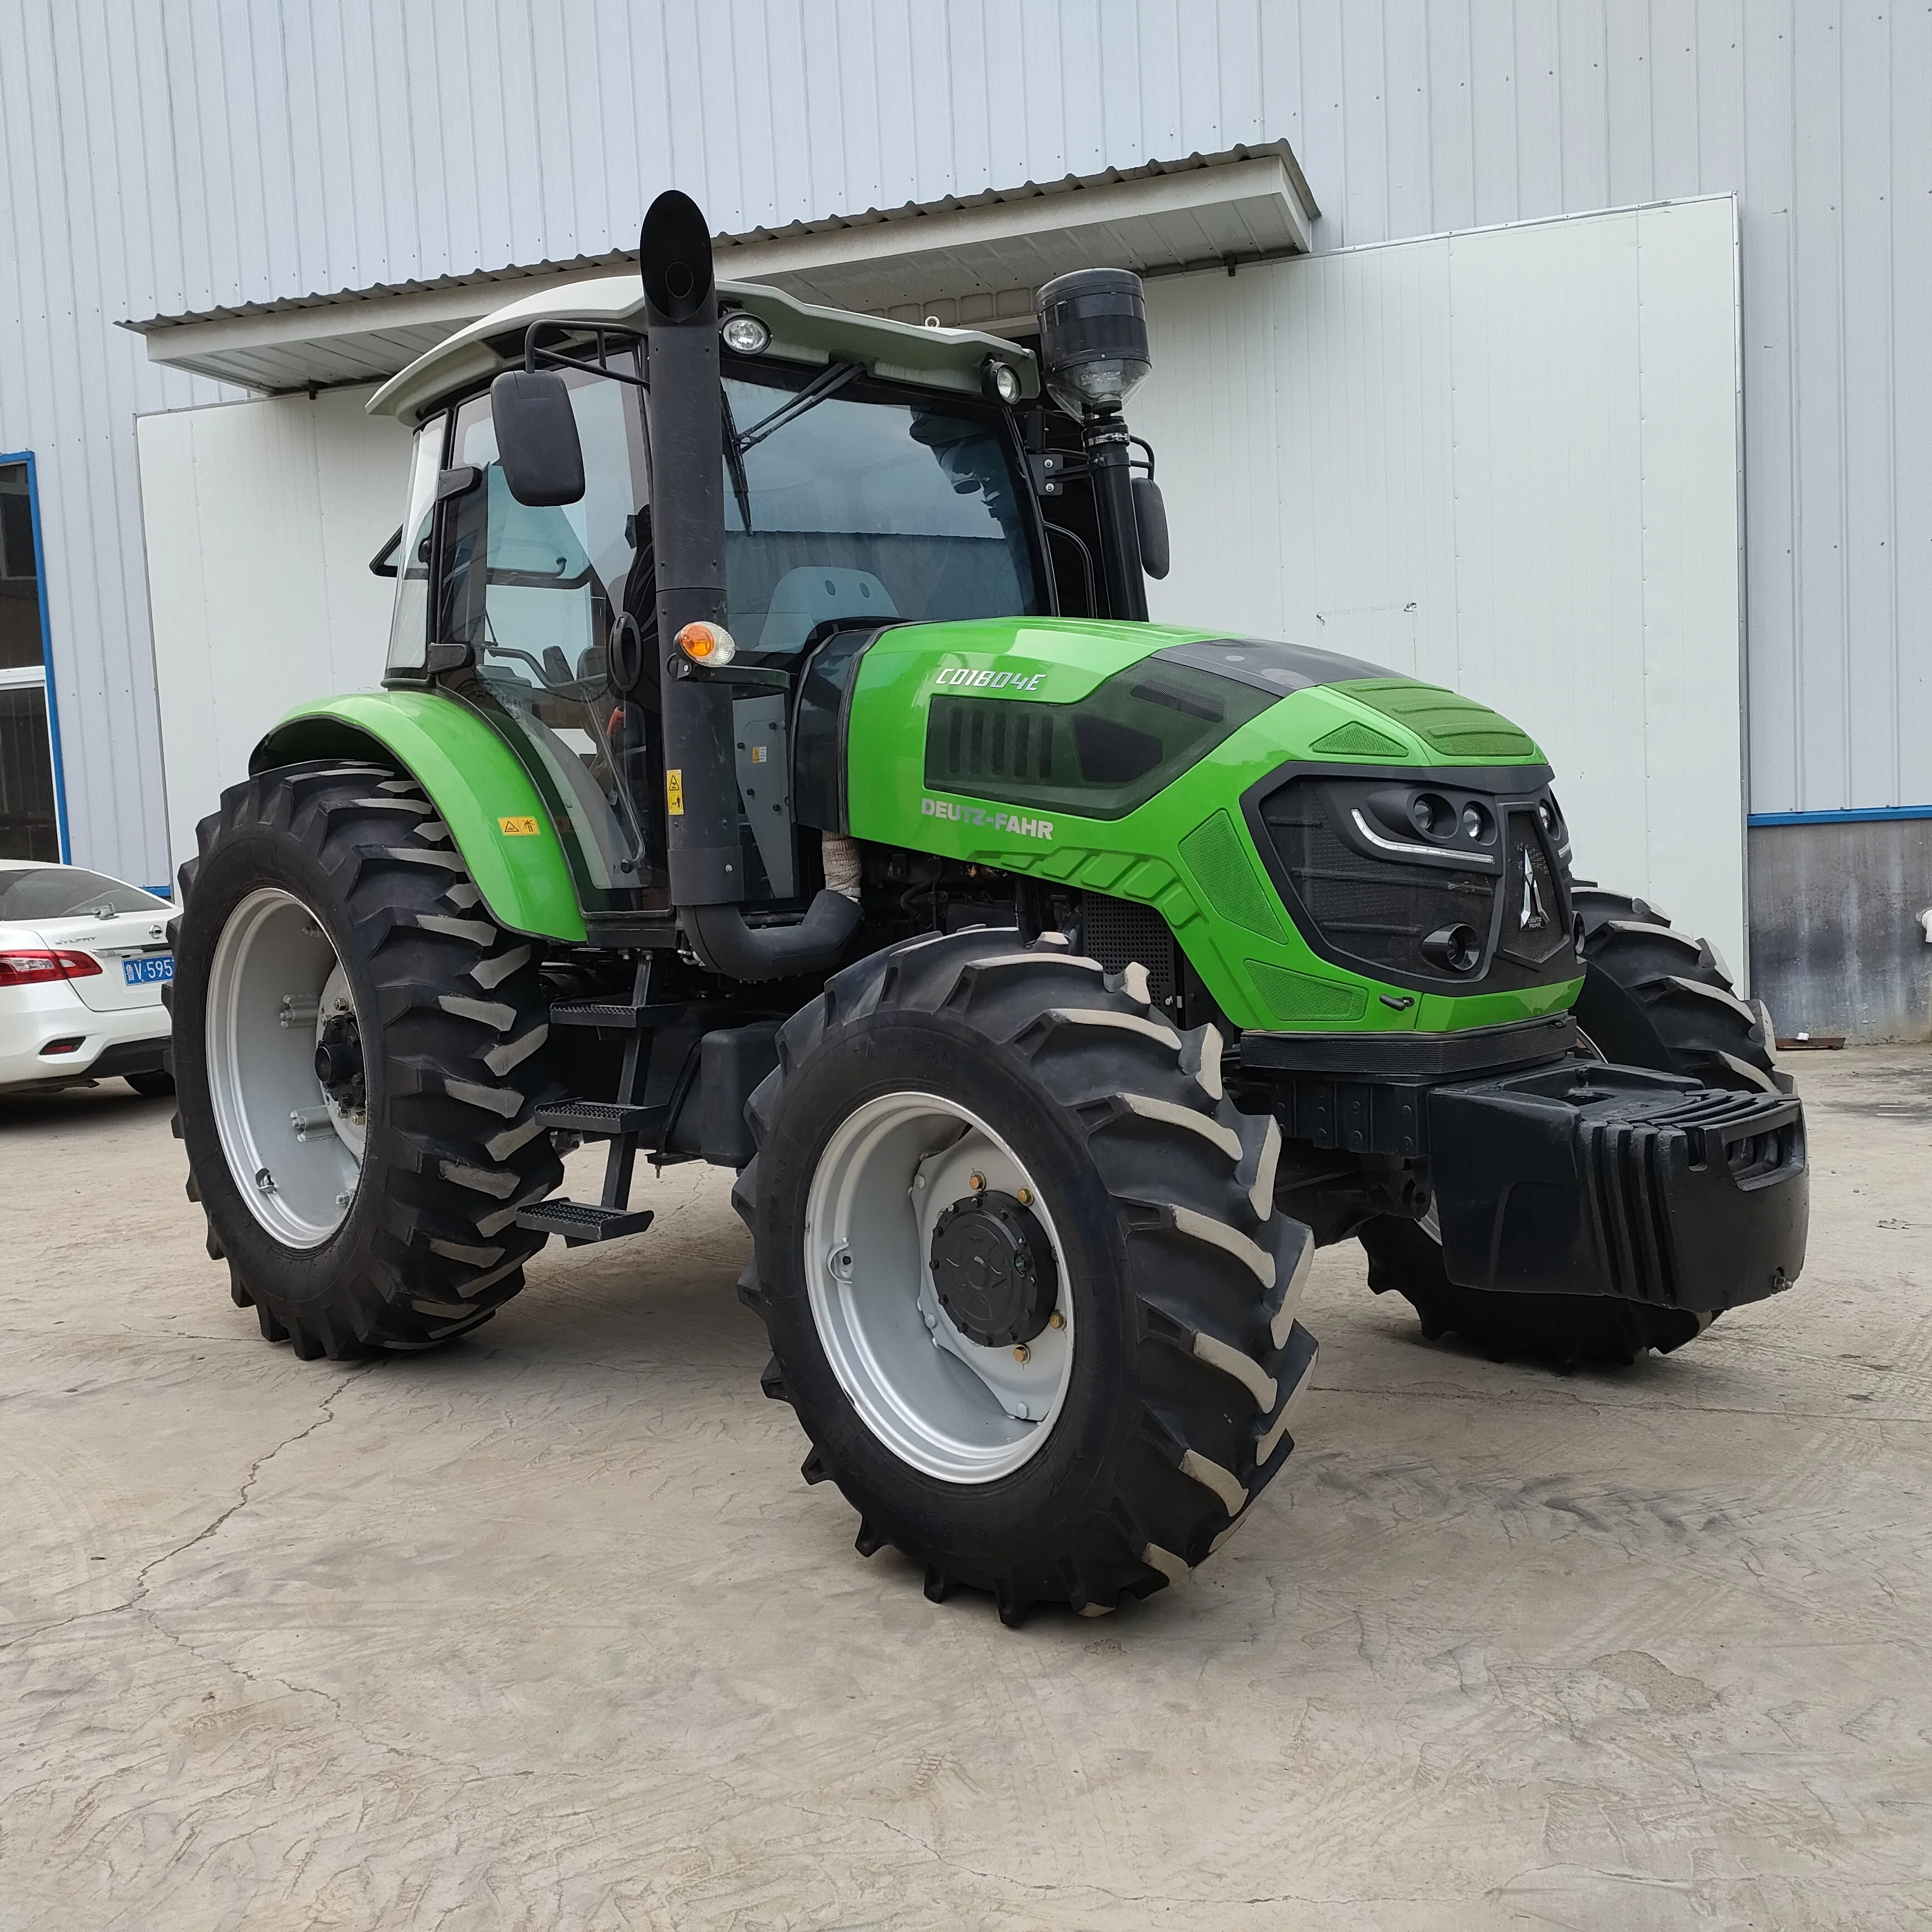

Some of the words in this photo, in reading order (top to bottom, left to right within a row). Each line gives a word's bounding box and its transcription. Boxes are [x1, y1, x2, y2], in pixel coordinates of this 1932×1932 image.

[935, 669, 1047, 691] CD1804E
[921, 798, 1053, 840] DEUTZ-FAHR
[54, 935, 97, 944] SYLPHY
